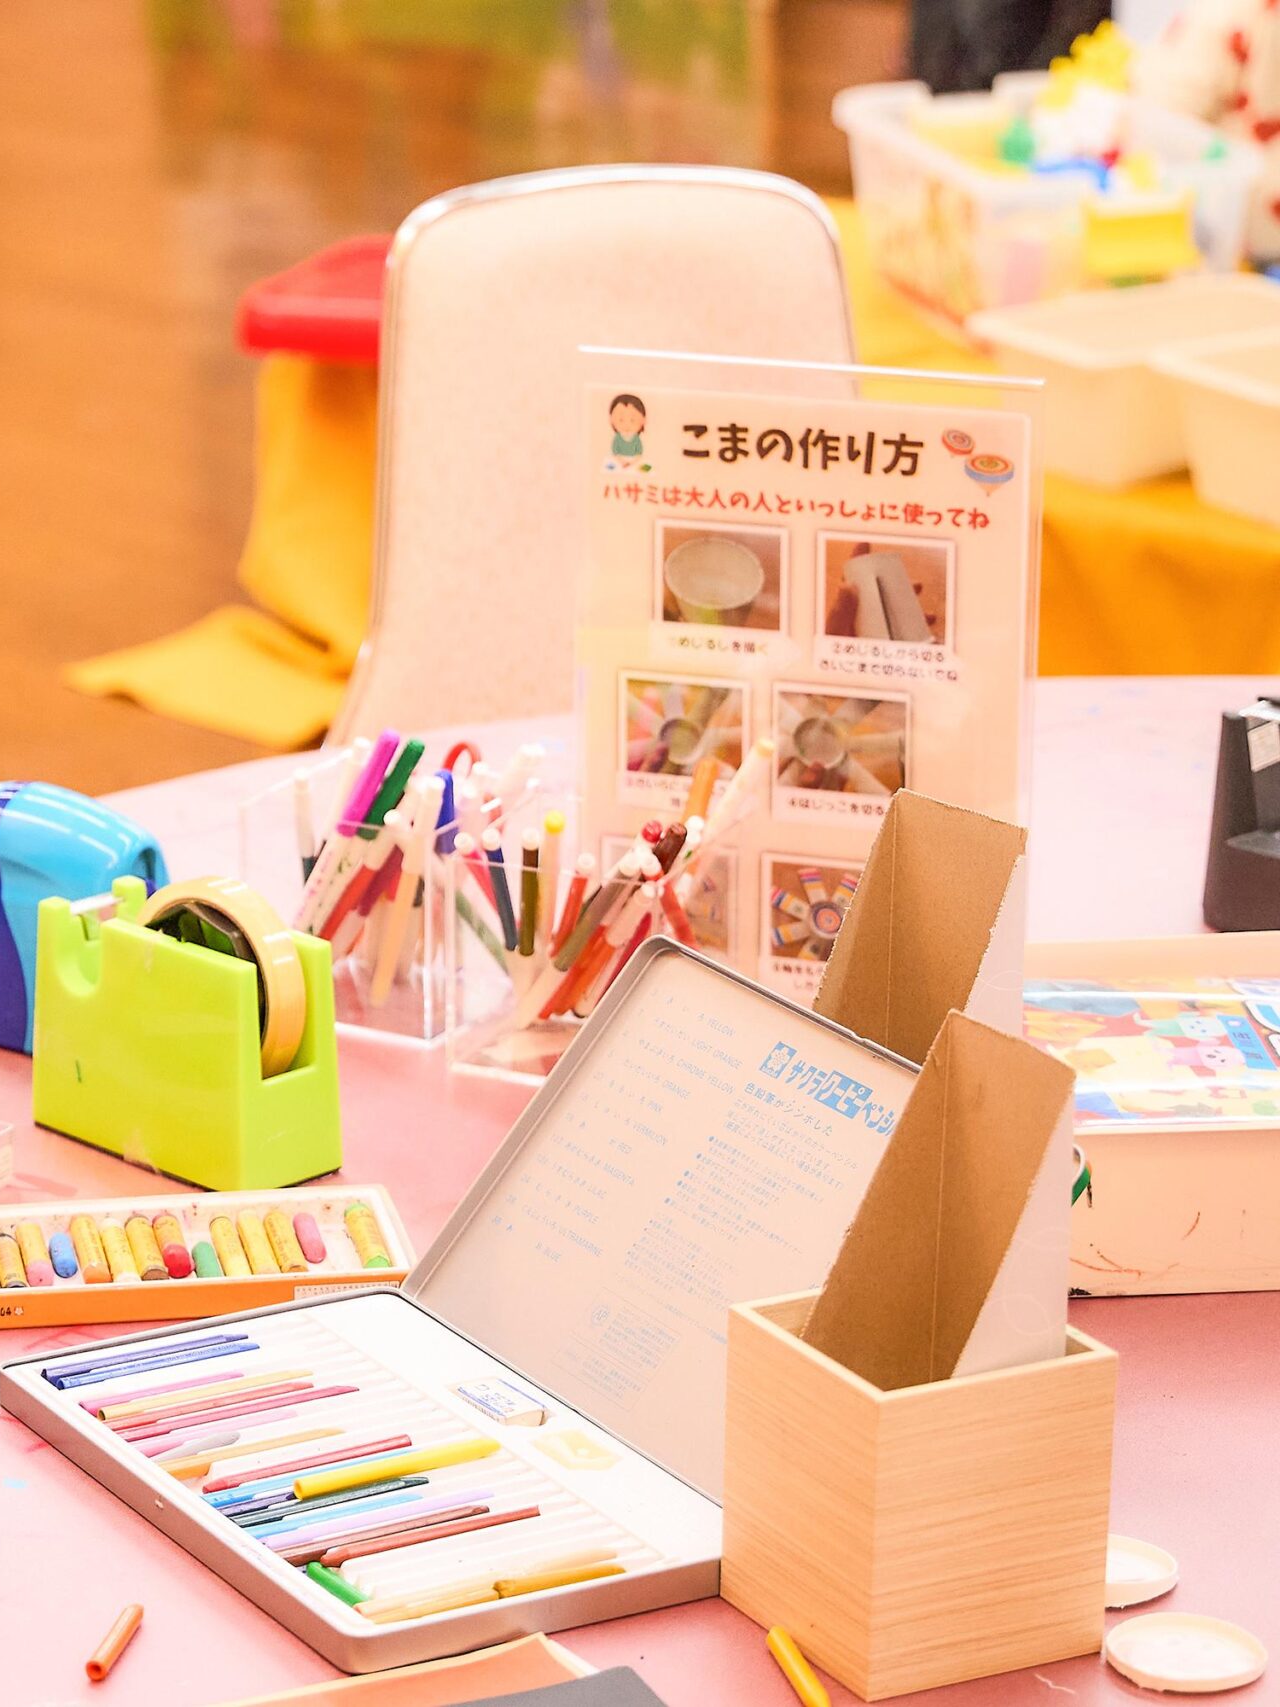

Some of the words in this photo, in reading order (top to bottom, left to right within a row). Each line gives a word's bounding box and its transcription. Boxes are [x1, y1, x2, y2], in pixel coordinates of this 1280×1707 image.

[682, 423, 924, 477] こまの作り方
[602, 482, 991, 531] ハサミは大人の人といっしょに使ってね
[705, 1016, 736, 1038] YELLOW
[711, 1047, 743, 1071] ORANGE
[660, 1078, 691, 1101] ORANGE
[676, 1057, 706, 1080] CHROME
[705, 1073, 735, 1095] YELLOW
